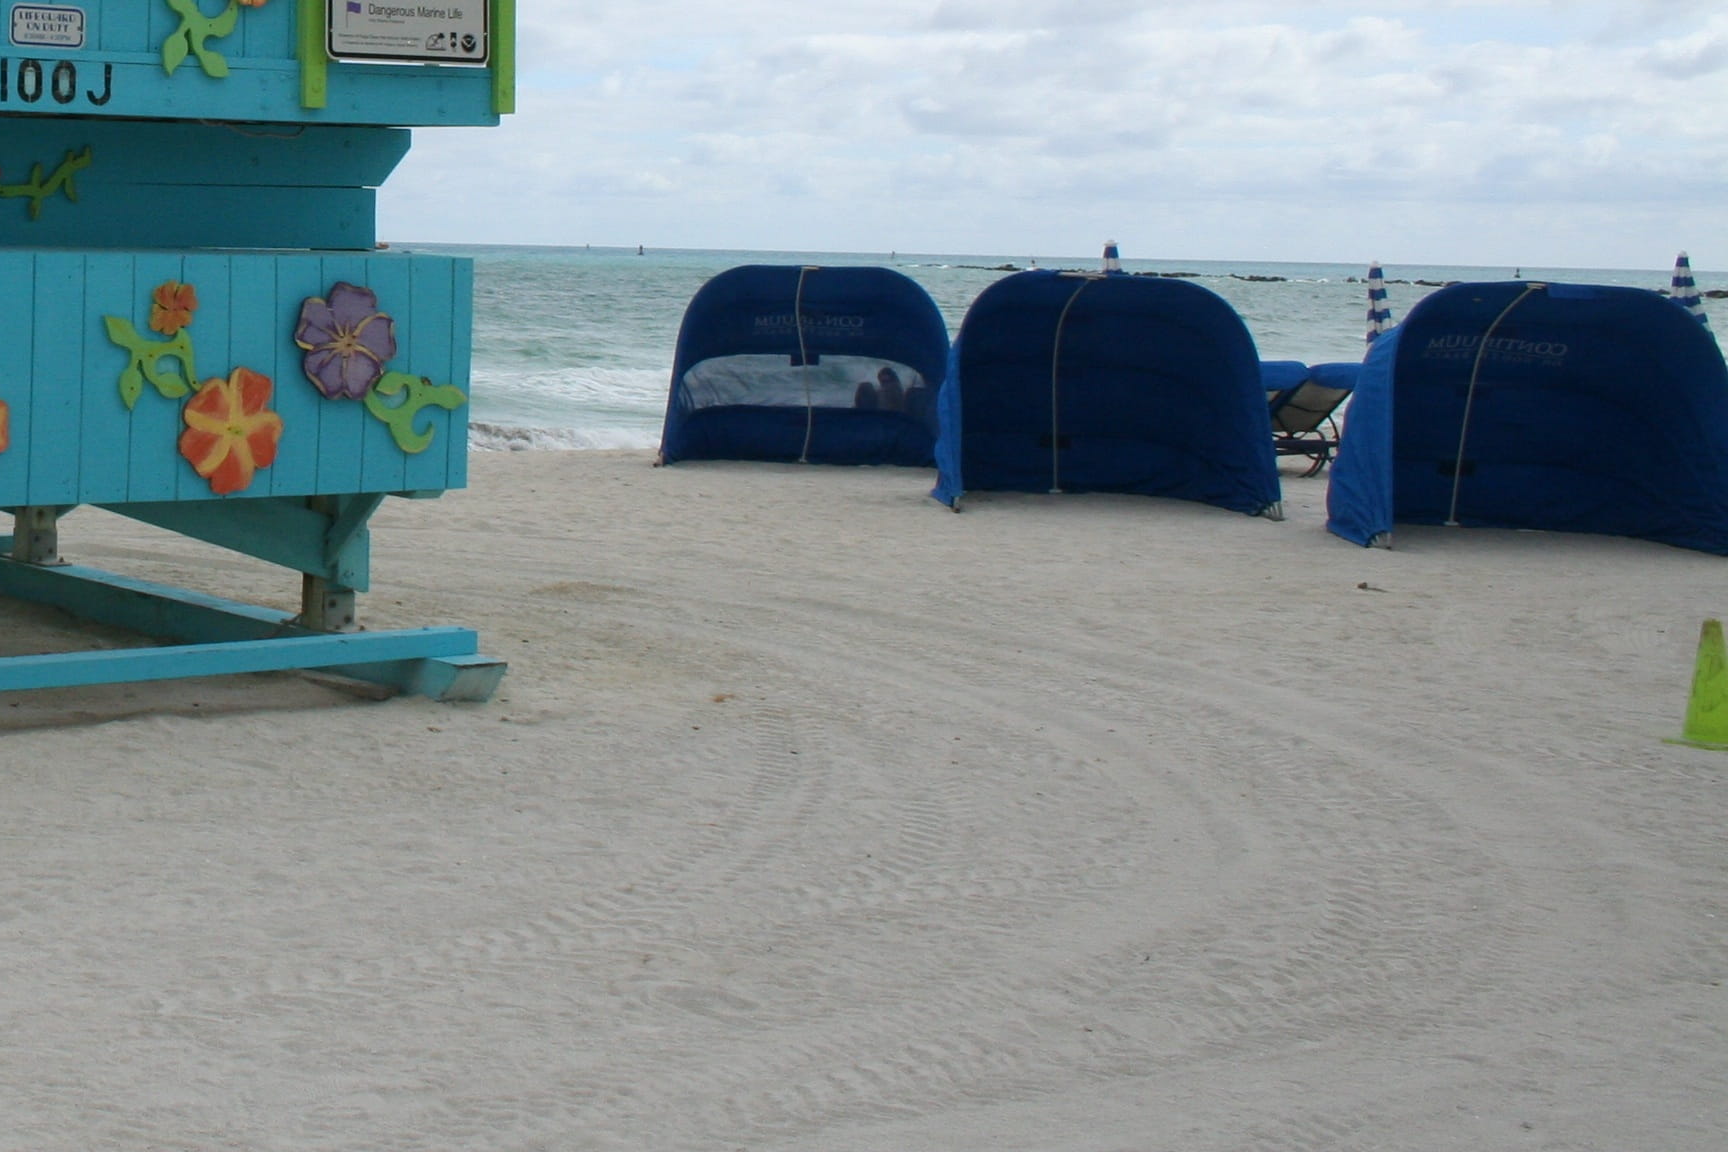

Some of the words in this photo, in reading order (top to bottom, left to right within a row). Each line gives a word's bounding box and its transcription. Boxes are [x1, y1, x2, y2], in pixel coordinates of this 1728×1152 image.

[19, 11, 76, 23] LIFEGUARD
[368, 2, 416, 19] Dangerous
[417, 6, 446, 19] Marine
[447, 7, 463, 20] Life
